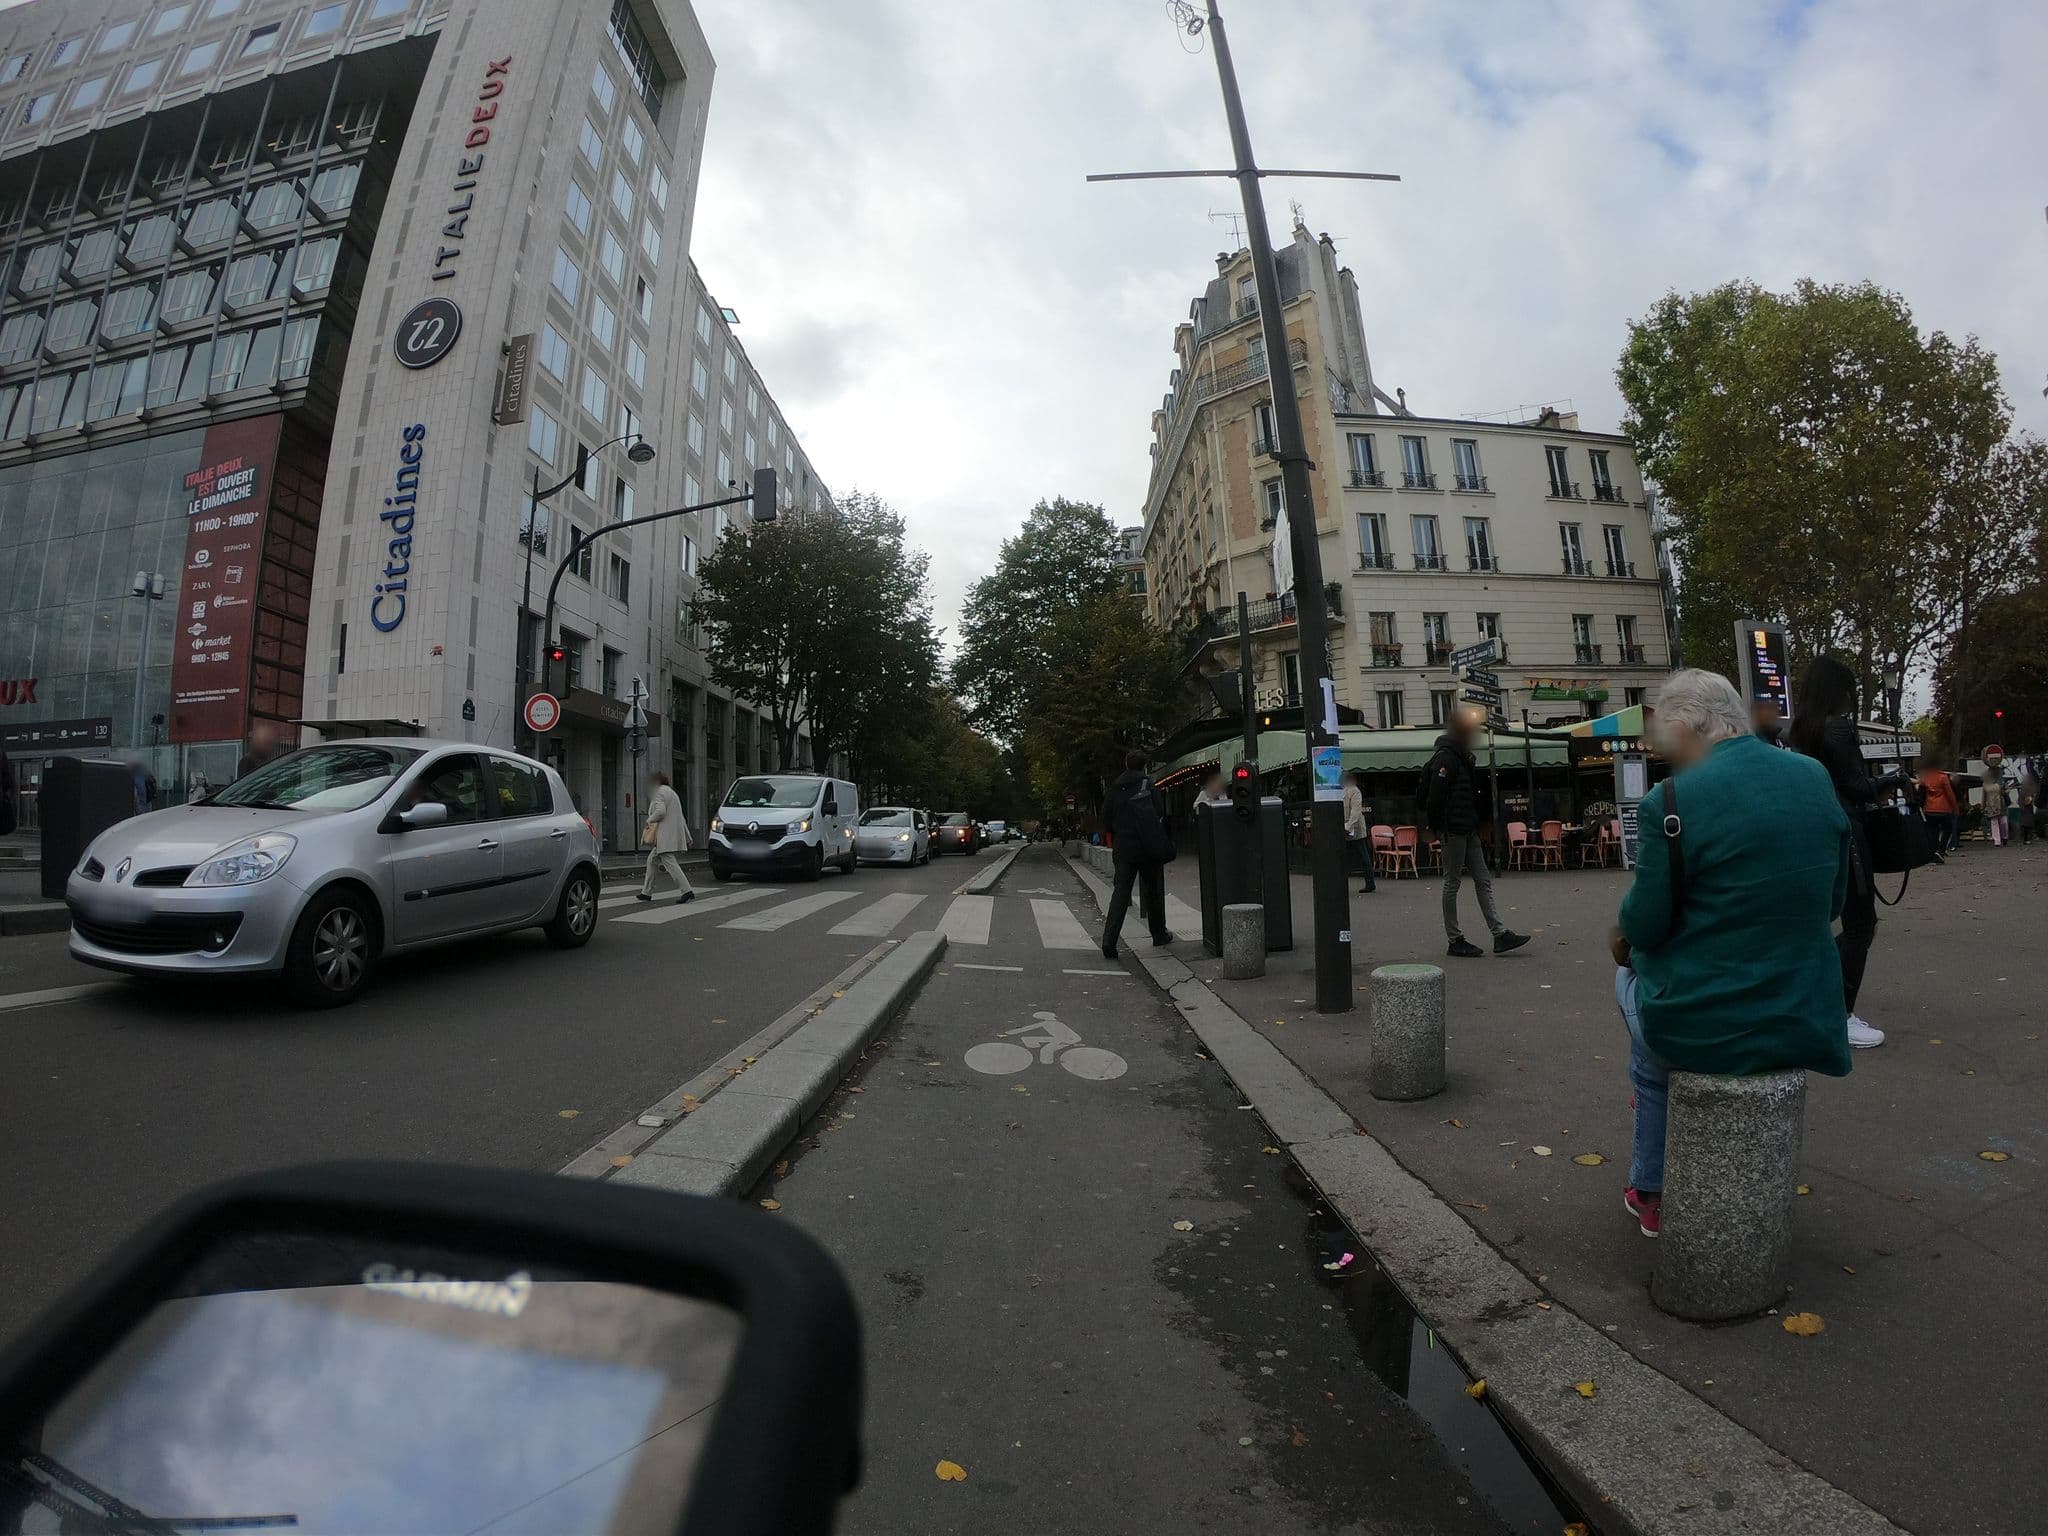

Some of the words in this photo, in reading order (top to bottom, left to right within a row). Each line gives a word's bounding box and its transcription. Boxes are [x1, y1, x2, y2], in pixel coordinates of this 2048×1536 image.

[431, 153, 484, 282] ITALIE
[465, 55, 512, 148] DEUX
[508, 344, 527, 412] citadines
[186, 467, 215, 487] ITALIE
[216, 457, 242, 476] DEUX
[198, 480, 216, 496] EST
[218, 468, 255, 491] OUVERT
[189, 500, 201, 514] LE
[202, 484, 252, 511] DIMANCHE
[195, 517, 221, 533] 11H00
[370, 423, 426, 633] Citadines
[223, 543, 251, 553] SEPHORA
[192, 581, 211, 590] ZARA
[204, 636, 232, 647] market
[1255, 688, 1284, 710] LES
